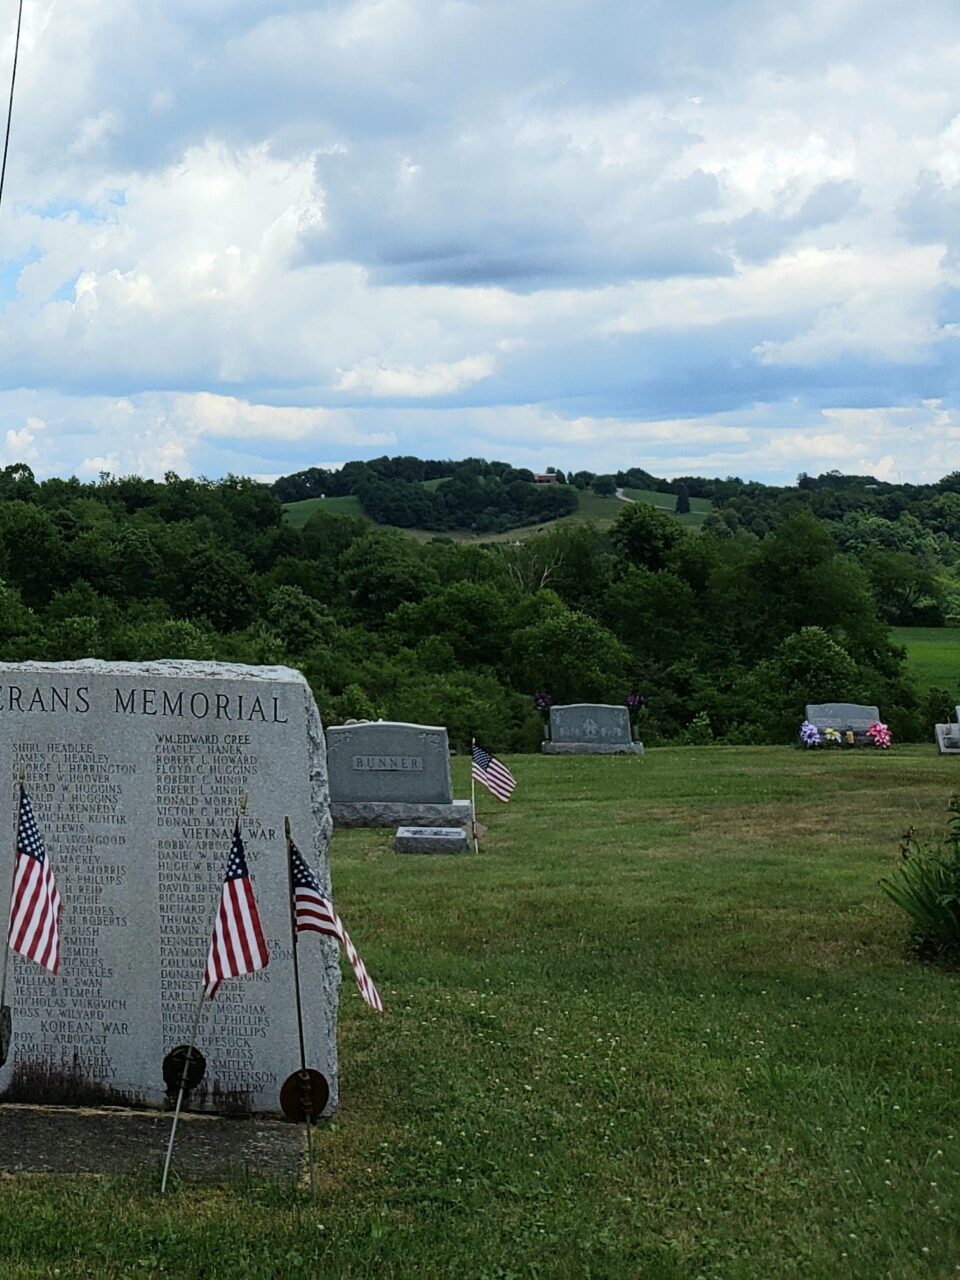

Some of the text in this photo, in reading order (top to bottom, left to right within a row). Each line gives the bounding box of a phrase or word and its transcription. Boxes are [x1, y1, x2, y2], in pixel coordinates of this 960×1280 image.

[114, 688, 288, 724] MEMORIAL
[223, 734, 252, 746] CREE
[13, 743, 93, 755] SHIRL HEADLEE
[154, 744, 201, 755] CHARLES
[13, 753, 110, 765] JAMES HEADLEY
[156, 754, 258, 766] ROBERT HOWARD
[356, 756, 419, 768] BUNNER
[69, 764, 136, 775] HERRINGTON
[156, 764, 259, 777] FLOYD HUGGINS
[69, 773, 111, 785] HOOVER
[156, 775, 249, 787] ROBERT MINOR
[75, 783, 123, 795] HUGGINS
[156, 784, 245, 797] ROBERT MINOR
[72, 793, 119, 805] HUGGINS
[156, 795, 199, 807] RONALD
[69, 803, 117, 815] KENNEDY
[156, 806, 195, 817] VICTOR
[157, 816, 201, 828] DONALD
[56, 824, 86, 834] LEWIS
[247, 828, 277, 841] WAR
[59, 844, 94, 855] LYNCH
[158, 839, 191, 851] BOBBY
[59, 855, 100, 865] MACKEY
[158, 850, 194, 862] DANIEL
[87, 864, 127, 876] MORRIS
[158, 860, 189, 872] HUGH
[77, 874, 122, 886] PHILLIPS
[158, 871, 202, 883] DONALD
[79, 885, 103, 895] REID
[158, 882, 191, 893] DAVID
[159, 893, 205, 904] RICHARD
[72, 905, 115, 916] RHODES
[159, 904, 206, 915] RICHARD
[82, 916, 127, 927] ROBERTS
[160, 915, 204, 926] THOMAS
[71, 926, 100, 937] RUSH
[160, 925, 199, 936] MARVIN
[64, 936, 95, 947] SMITH
[160, 936, 208, 948] KENNETH
[66, 947, 98, 958] SMITH
[63, 967, 114, 979] STICKLES
[13, 975, 103, 989] WILLIAM SWAN
[160, 979, 202, 991] ERNEST
[13, 986, 103, 999] JESSE TEMPLE
[160, 990, 186, 1002] EARL
[13, 996, 127, 1011] NICHOLAS VUKOVICH
[13, 1007, 105, 1021] ROSS WILYARD
[224, 1014, 270, 1027] PHILLIPS
[40, 1019, 130, 1036] KOREAN WAR
[220, 1025, 267, 1039] PHILLIPS
[14, 1031, 109, 1045] ROY ARBOGAST
[201, 1036, 251, 1048] PRESOCK
[14, 1042, 108, 1056] SAMUEL BLACK
[226, 1048, 255, 1060] ROSS
[212, 1059, 256, 1071] SMITLEY
[215, 1070, 277, 1083] STEVENSON
